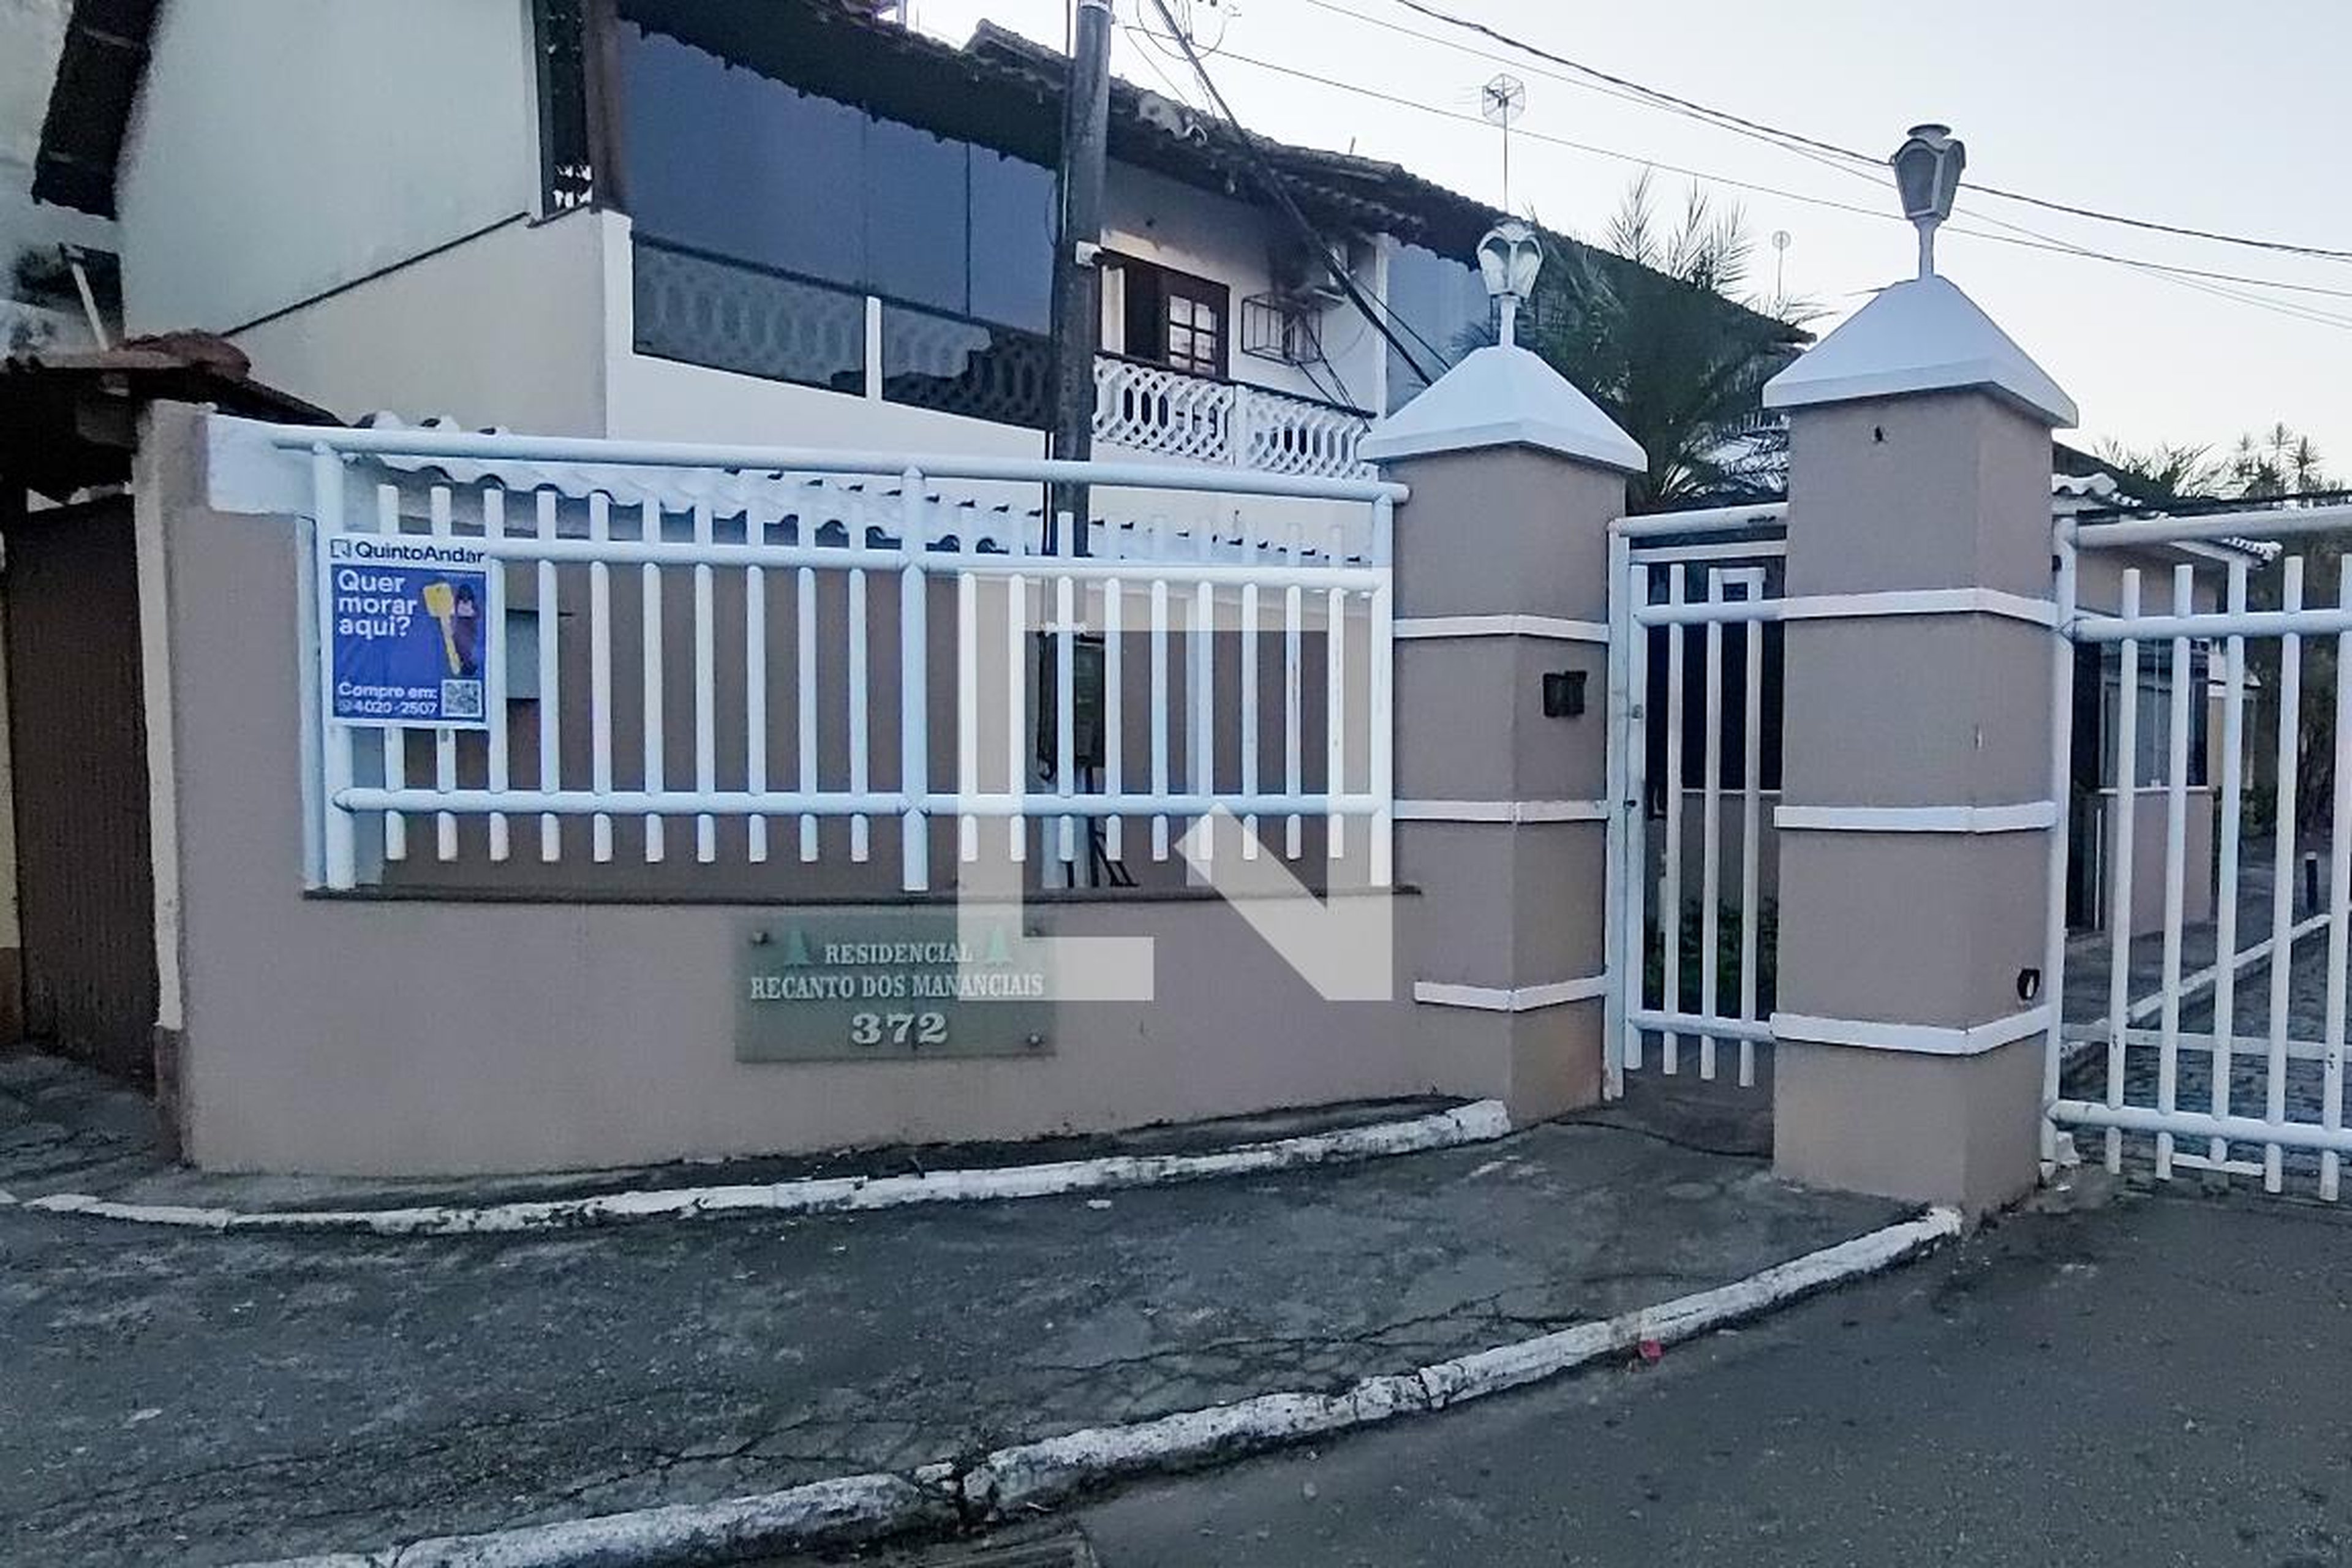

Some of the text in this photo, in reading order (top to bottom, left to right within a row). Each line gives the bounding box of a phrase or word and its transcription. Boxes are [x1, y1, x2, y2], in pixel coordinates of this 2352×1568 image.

[356, 541, 484, 564] QuintoAndar
[338, 570, 405, 592] Quer
[338, 597, 417, 616] morar
[339, 616, 411, 640] aqui?
[825, 942, 974, 964] RESIDENCIAL
[751, 973, 1044, 1000] RECANTO DOS MANANCIAIS
[851, 1012, 948, 1044] 372
